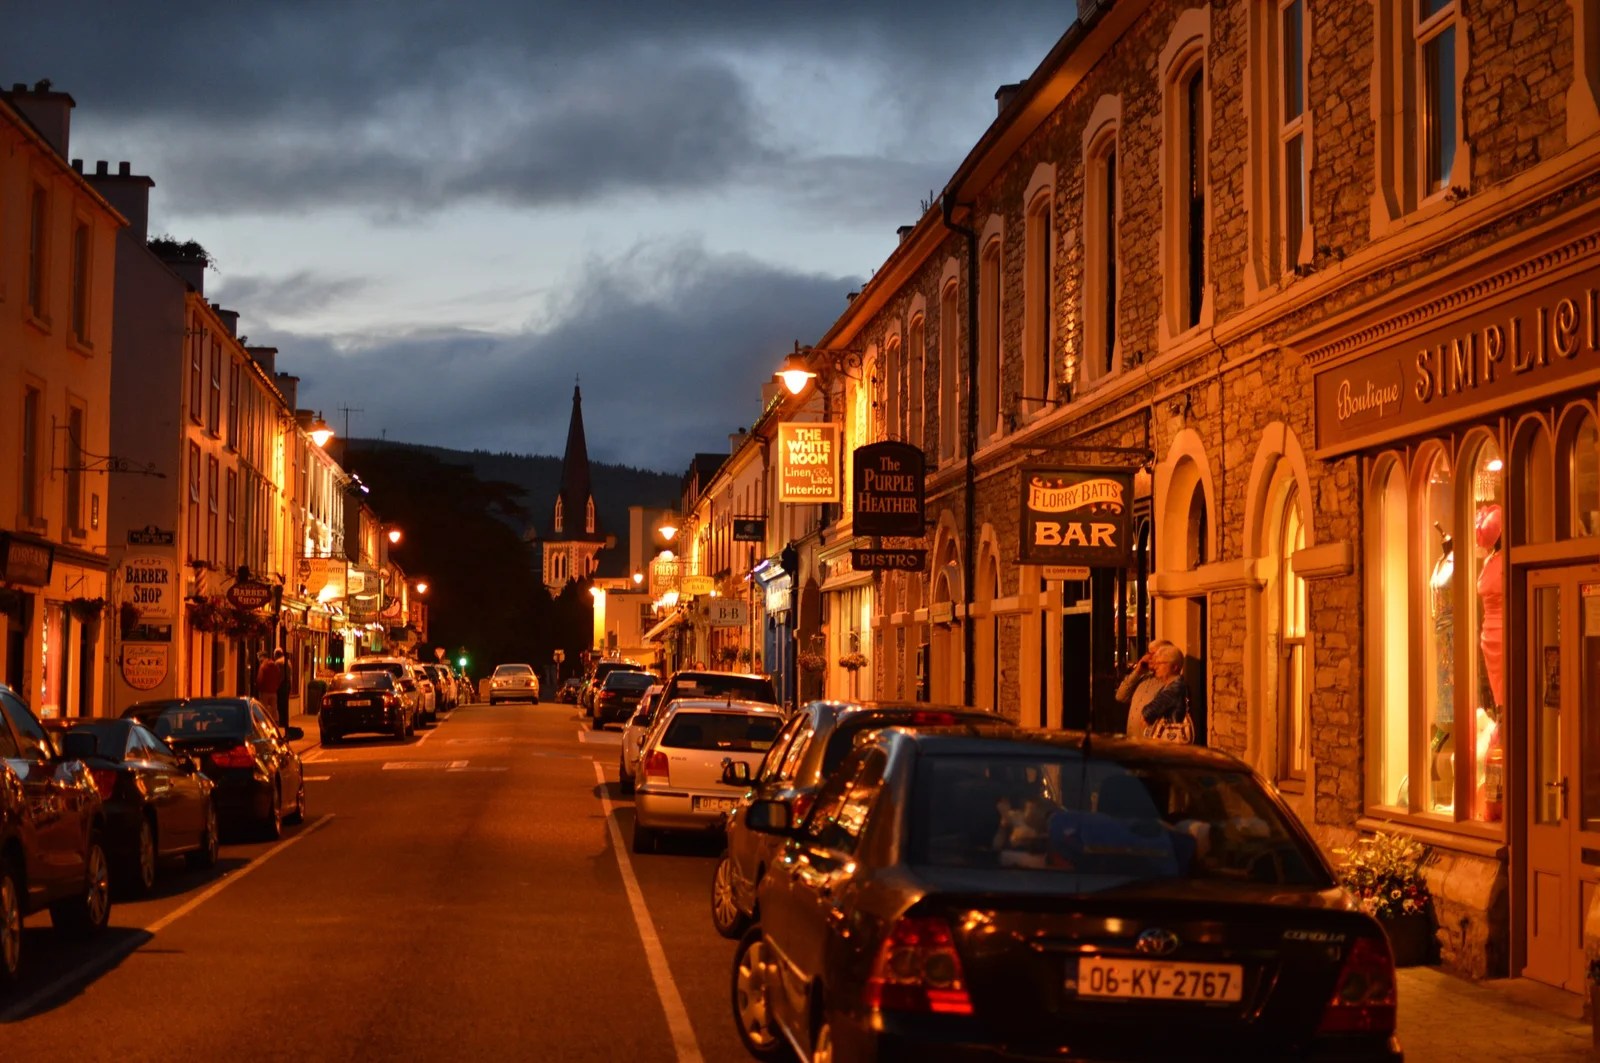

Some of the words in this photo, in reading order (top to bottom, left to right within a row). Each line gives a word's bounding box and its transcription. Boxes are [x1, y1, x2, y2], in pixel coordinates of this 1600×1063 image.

[1337, 379, 1399, 421] Boutique
[795, 428, 822, 441] THE
[787, 440, 831, 453] WHITE
[789, 453, 828, 465] ROOM
[880, 456, 900, 471] The
[785, 467, 811, 477] Linen
[811, 474, 833, 484] Lace
[863, 468, 915, 492] PURPLE
[785, 482, 832, 495] Interiors
[857, 492, 918, 513] HEATHER
[1032, 488, 1079, 508] FLORRY
[1035, 521, 1117, 547] BAR
[860, 554, 918, 566] BISTRO
[125, 565, 168, 584] BARBER
[133, 585, 162, 604] SHOP
[233, 588, 268, 597] BARBER
[238, 596, 262, 605] SHOP
[131, 677, 158, 685] BAKERY
[1090, 967, 1231, 998] 06-KY-2767
